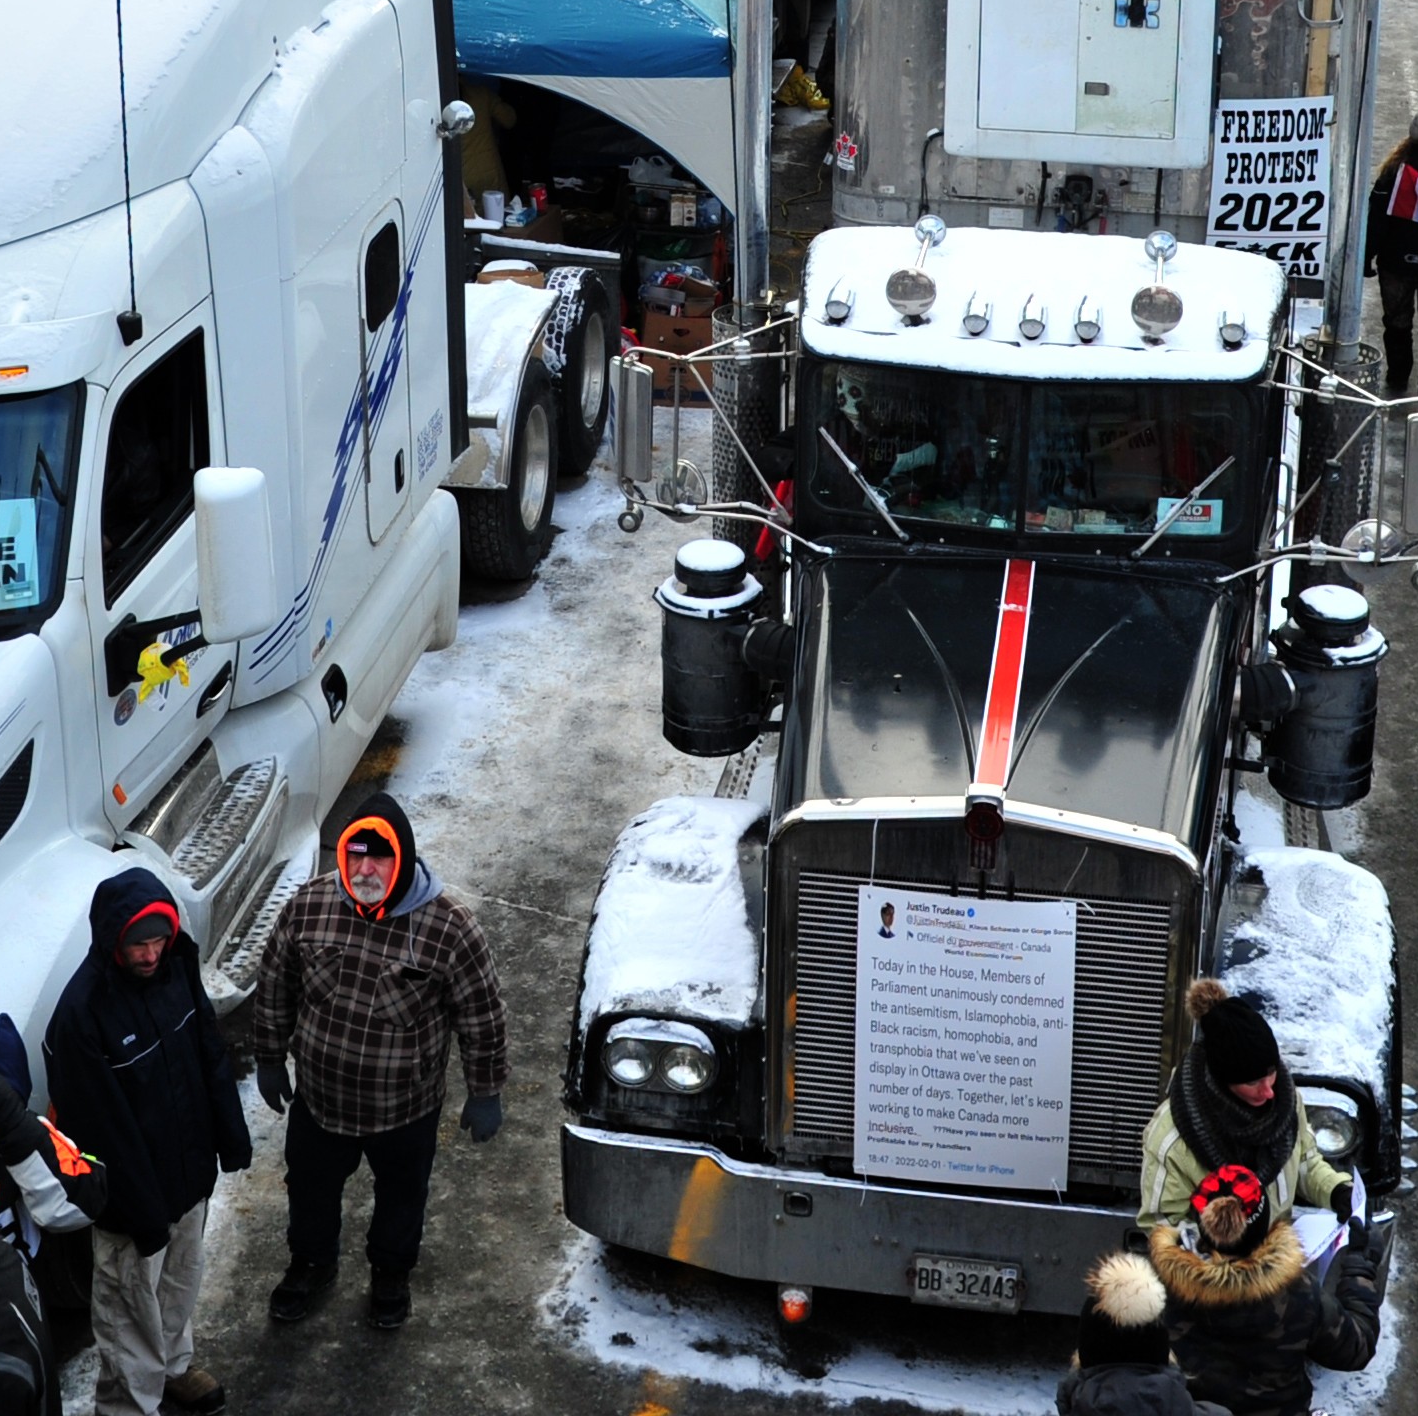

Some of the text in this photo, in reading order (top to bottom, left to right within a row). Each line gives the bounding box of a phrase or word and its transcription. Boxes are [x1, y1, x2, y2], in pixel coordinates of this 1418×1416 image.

[1220, 107, 1327, 144] FREEDOM
[1224, 148, 1319, 185] PROTEST
[1214, 190, 1326, 232] 2022
[906, 902, 965, 917] Justin Trudeau
[916, 933, 945, 944] Officiel
[946, 937, 957, 945] du
[1020, 941, 1051, 953] Canada
[966, 950, 999, 959] Economic
[872, 957, 1045, 985] Today in the House, Members of
[871, 979, 1064, 1009] Parliament unanimously condemned
[870, 1000, 1068, 1030] the antisemitism, Islamophobia, anti-
[870, 1020, 1037, 1047] Black racism, homophobia, and
[870, 1042, 1036, 1067] transphobia that we've seen on
[869, 1061, 1033, 1088] display in Ottawa over the past
[869, 1082, 1064, 1112] number of days. Together, let's keep
[869, 1102, 1029, 1126] working to make Canada more
[867, 1135, 906, 1145] Profitable
[936, 1142, 971, 1151] handlers
[1020, 1133, 1033, 1141] this
[868, 1154, 1015, 1175] 18:47 2022-02-01 Twitter for iPhone
[917, 1267, 1017, 1300] BB 32443
